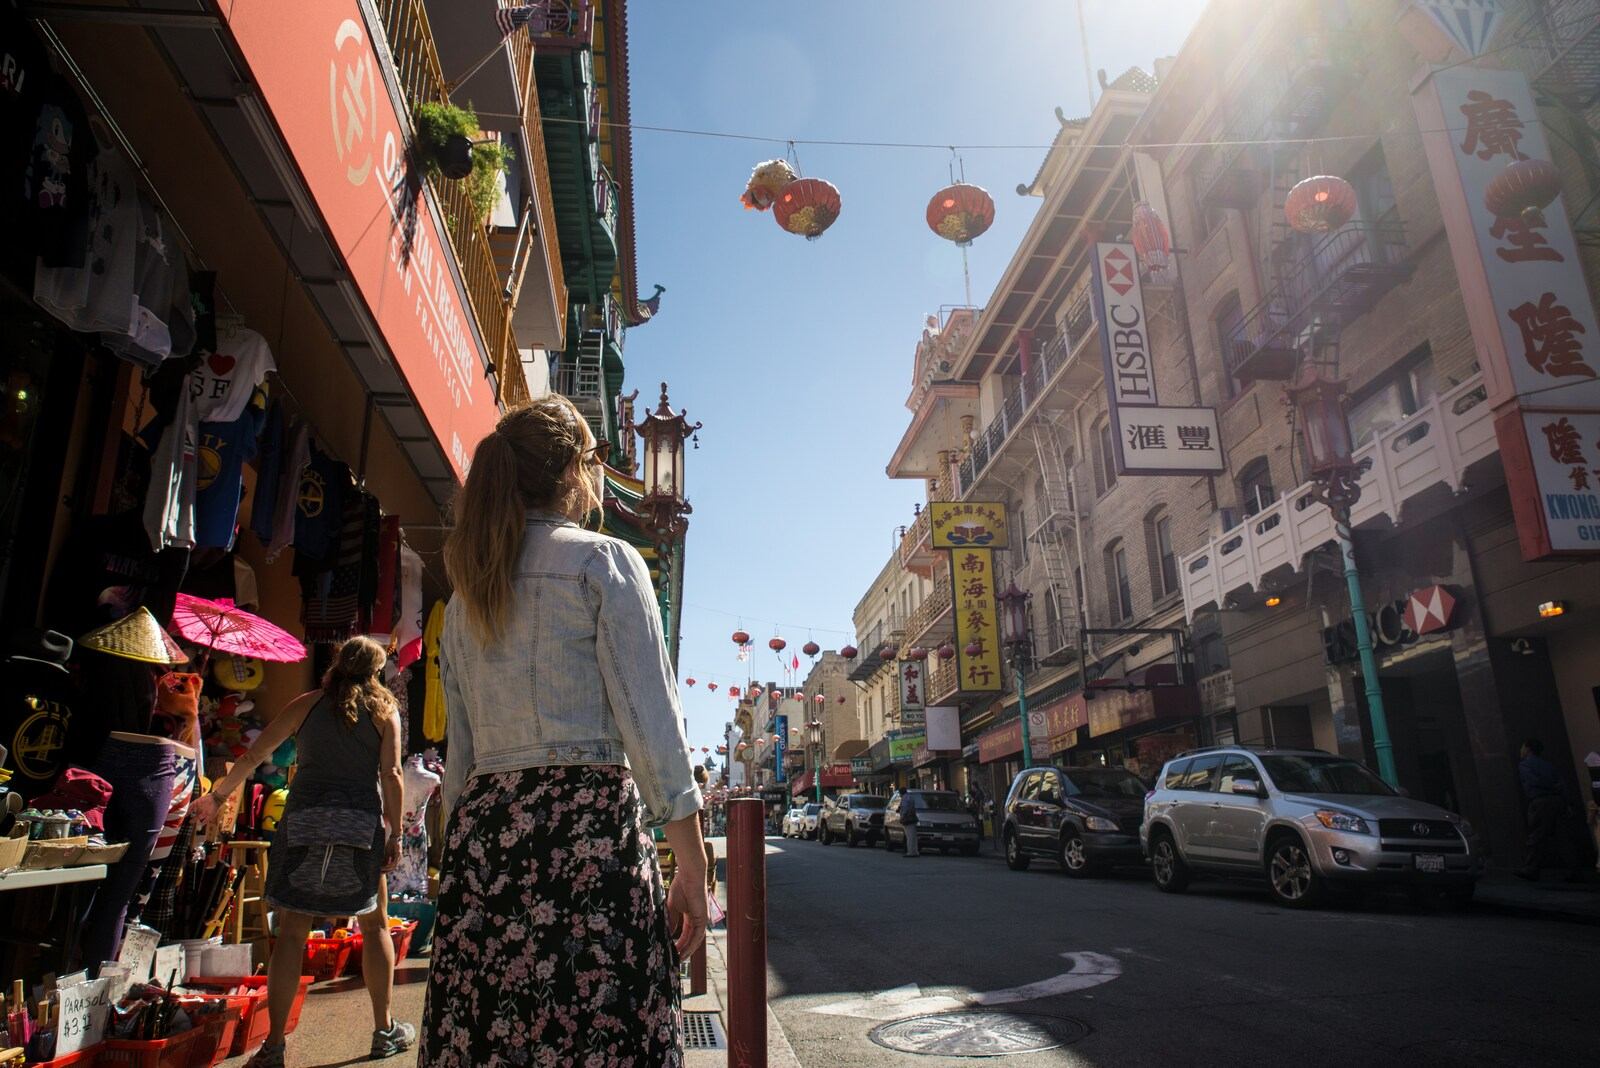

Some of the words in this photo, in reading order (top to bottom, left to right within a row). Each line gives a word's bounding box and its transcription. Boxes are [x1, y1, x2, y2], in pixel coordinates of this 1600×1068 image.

[0, 53, 25, 93] RI
[415, 295, 461, 409] FRANCISCO
[1110, 304, 1150, 399] HSBC
[1547, 494, 1600, 520] KWONG
[64, 990, 106, 1015] PARASOL
